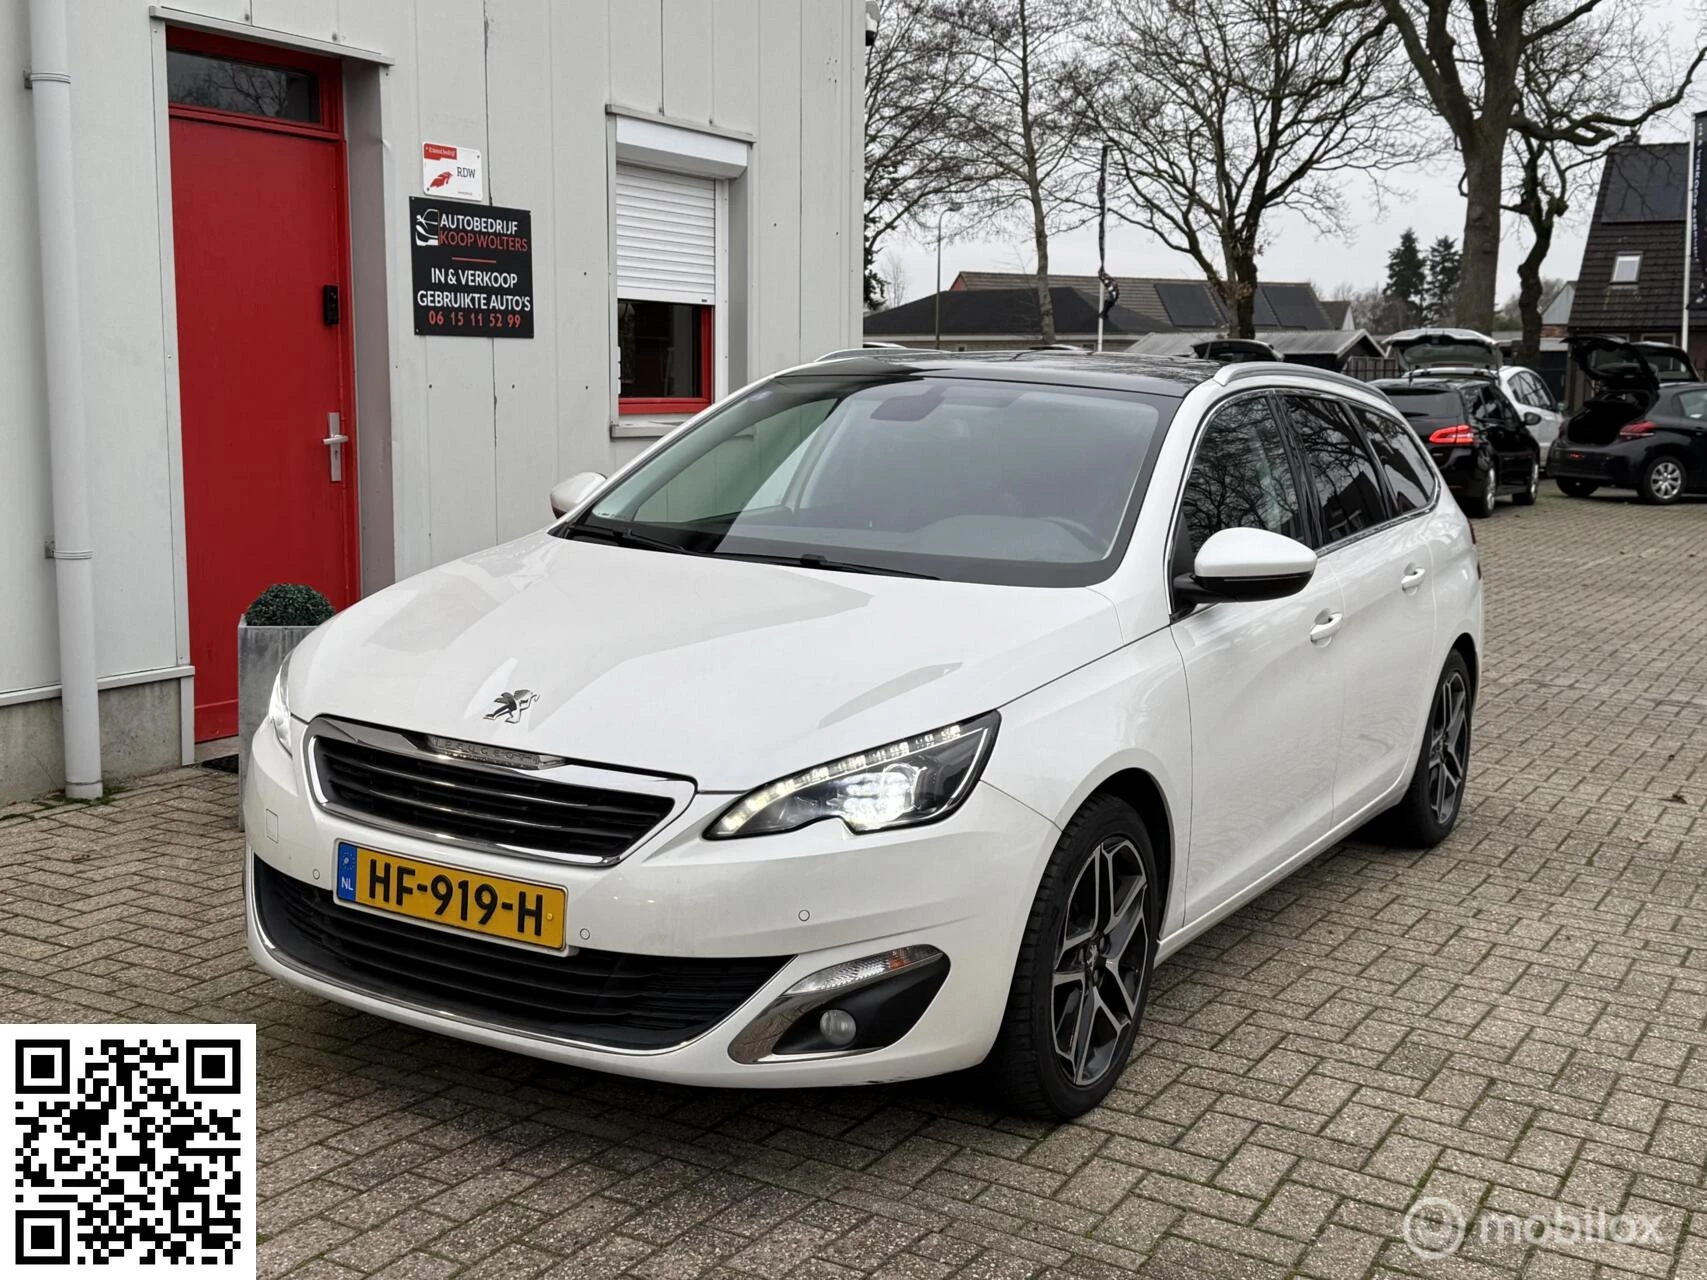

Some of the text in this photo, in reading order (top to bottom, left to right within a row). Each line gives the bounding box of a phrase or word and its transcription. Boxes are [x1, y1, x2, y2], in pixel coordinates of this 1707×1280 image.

[457, 166, 476, 179] RDW
[440, 214, 518, 235] AUTOBEDRIJF
[440, 231, 528, 252] KOOP WOLTERS
[431, 267, 518, 289] IN & VERKOOP
[417, 290, 531, 311] GEBRUIKTE AUTO'S
[428, 310, 521, 328] 06 15 11 52 99
[341, 876, 354, 891] NL
[369, 859, 543, 936] HF-919-H
